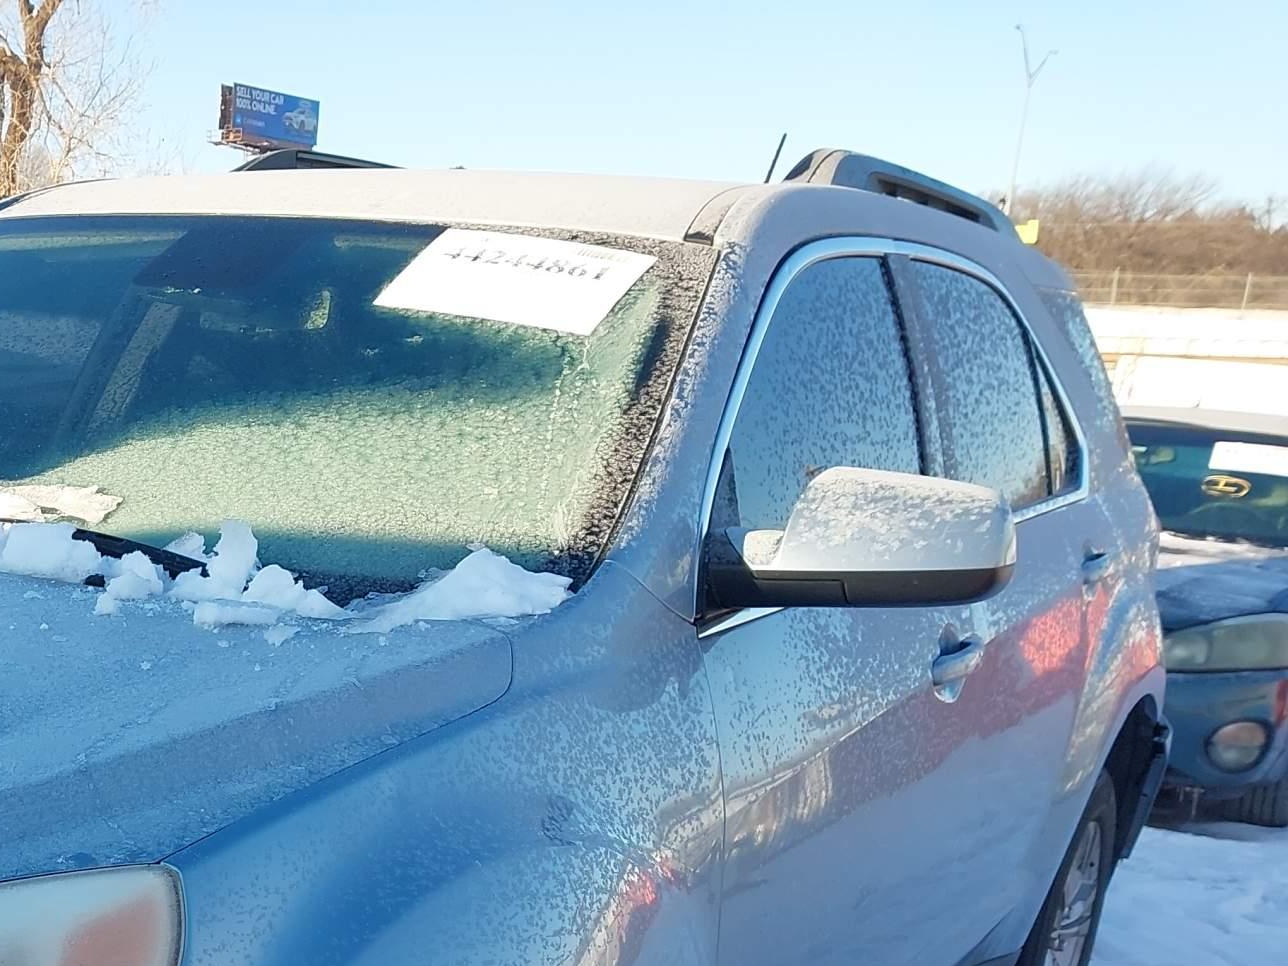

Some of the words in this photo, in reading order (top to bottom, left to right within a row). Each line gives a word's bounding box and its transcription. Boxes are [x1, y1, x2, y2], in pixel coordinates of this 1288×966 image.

[237, 86, 251, 98] SELL
[252, 88, 270, 102] YOUR
[251, 100, 277, 115] ONLINE
[441, 247, 610, 281] 44244861
